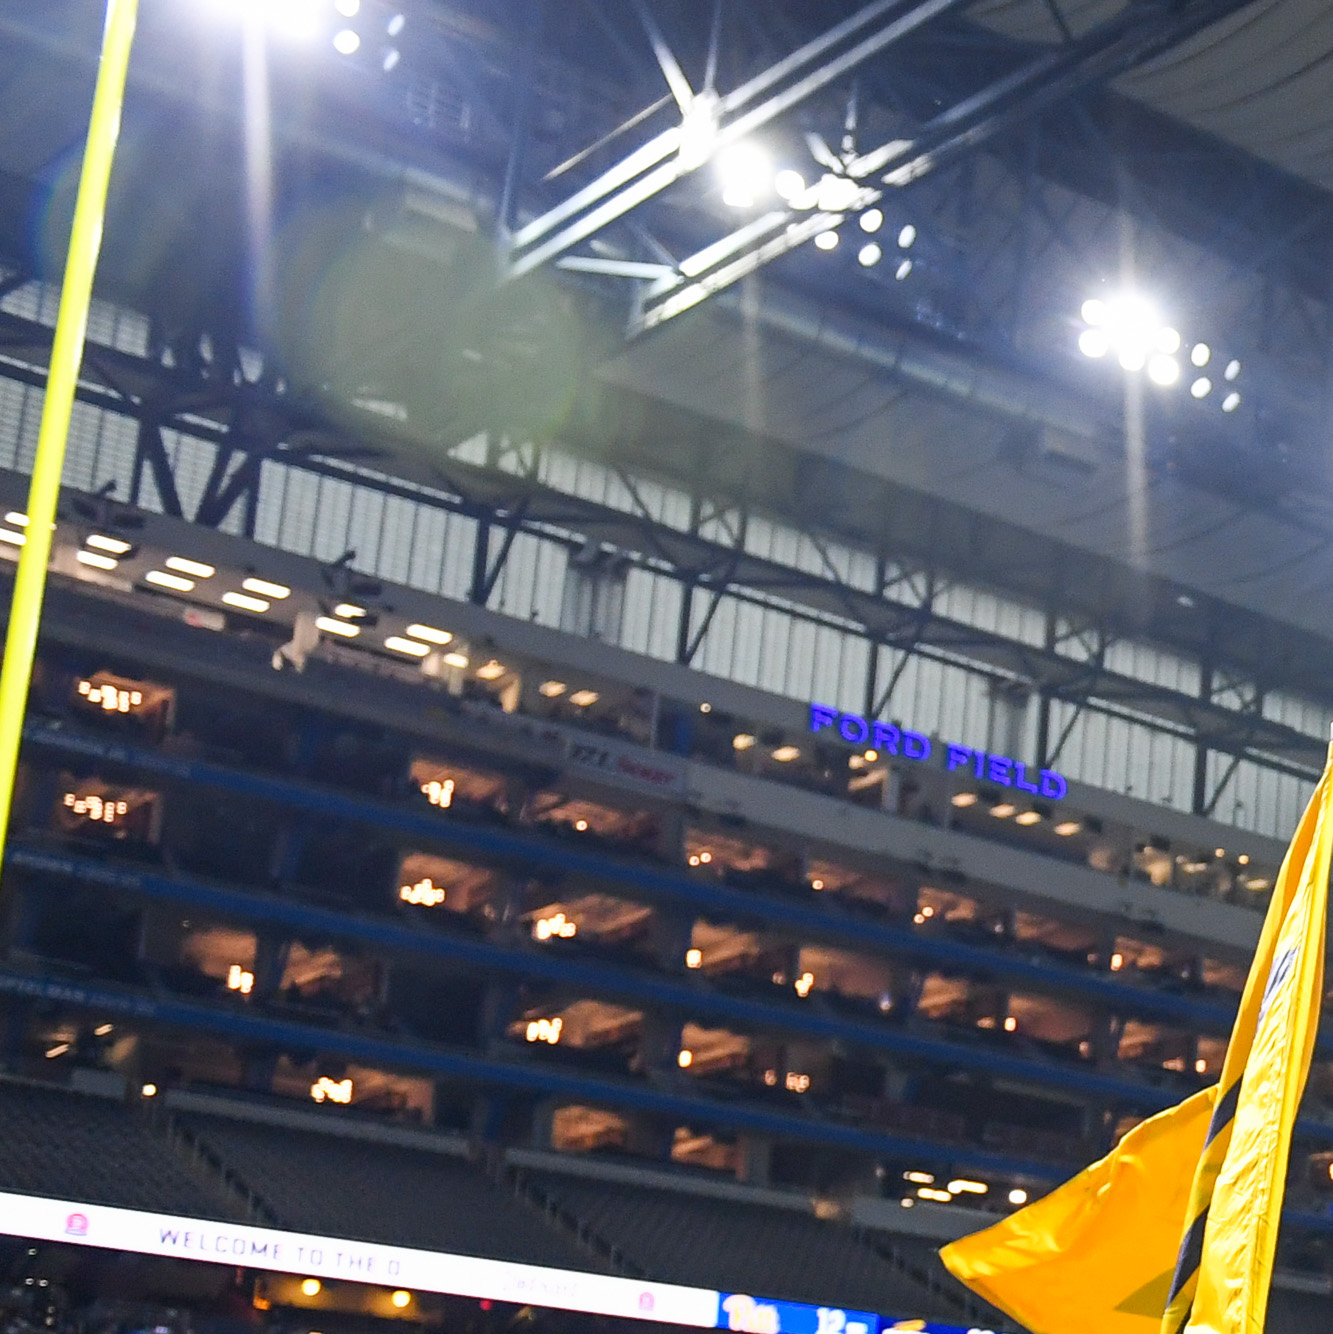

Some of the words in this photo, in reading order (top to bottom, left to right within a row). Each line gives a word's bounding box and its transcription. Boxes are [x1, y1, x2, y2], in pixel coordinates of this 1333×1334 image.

[811, 702, 931, 761] FORD
[946, 743, 1068, 800] FIELD
[159, 1227, 282, 1261] WELCOME
[296, 1245, 324, 1267] TO
[335, 1252, 376, 1274] THE
